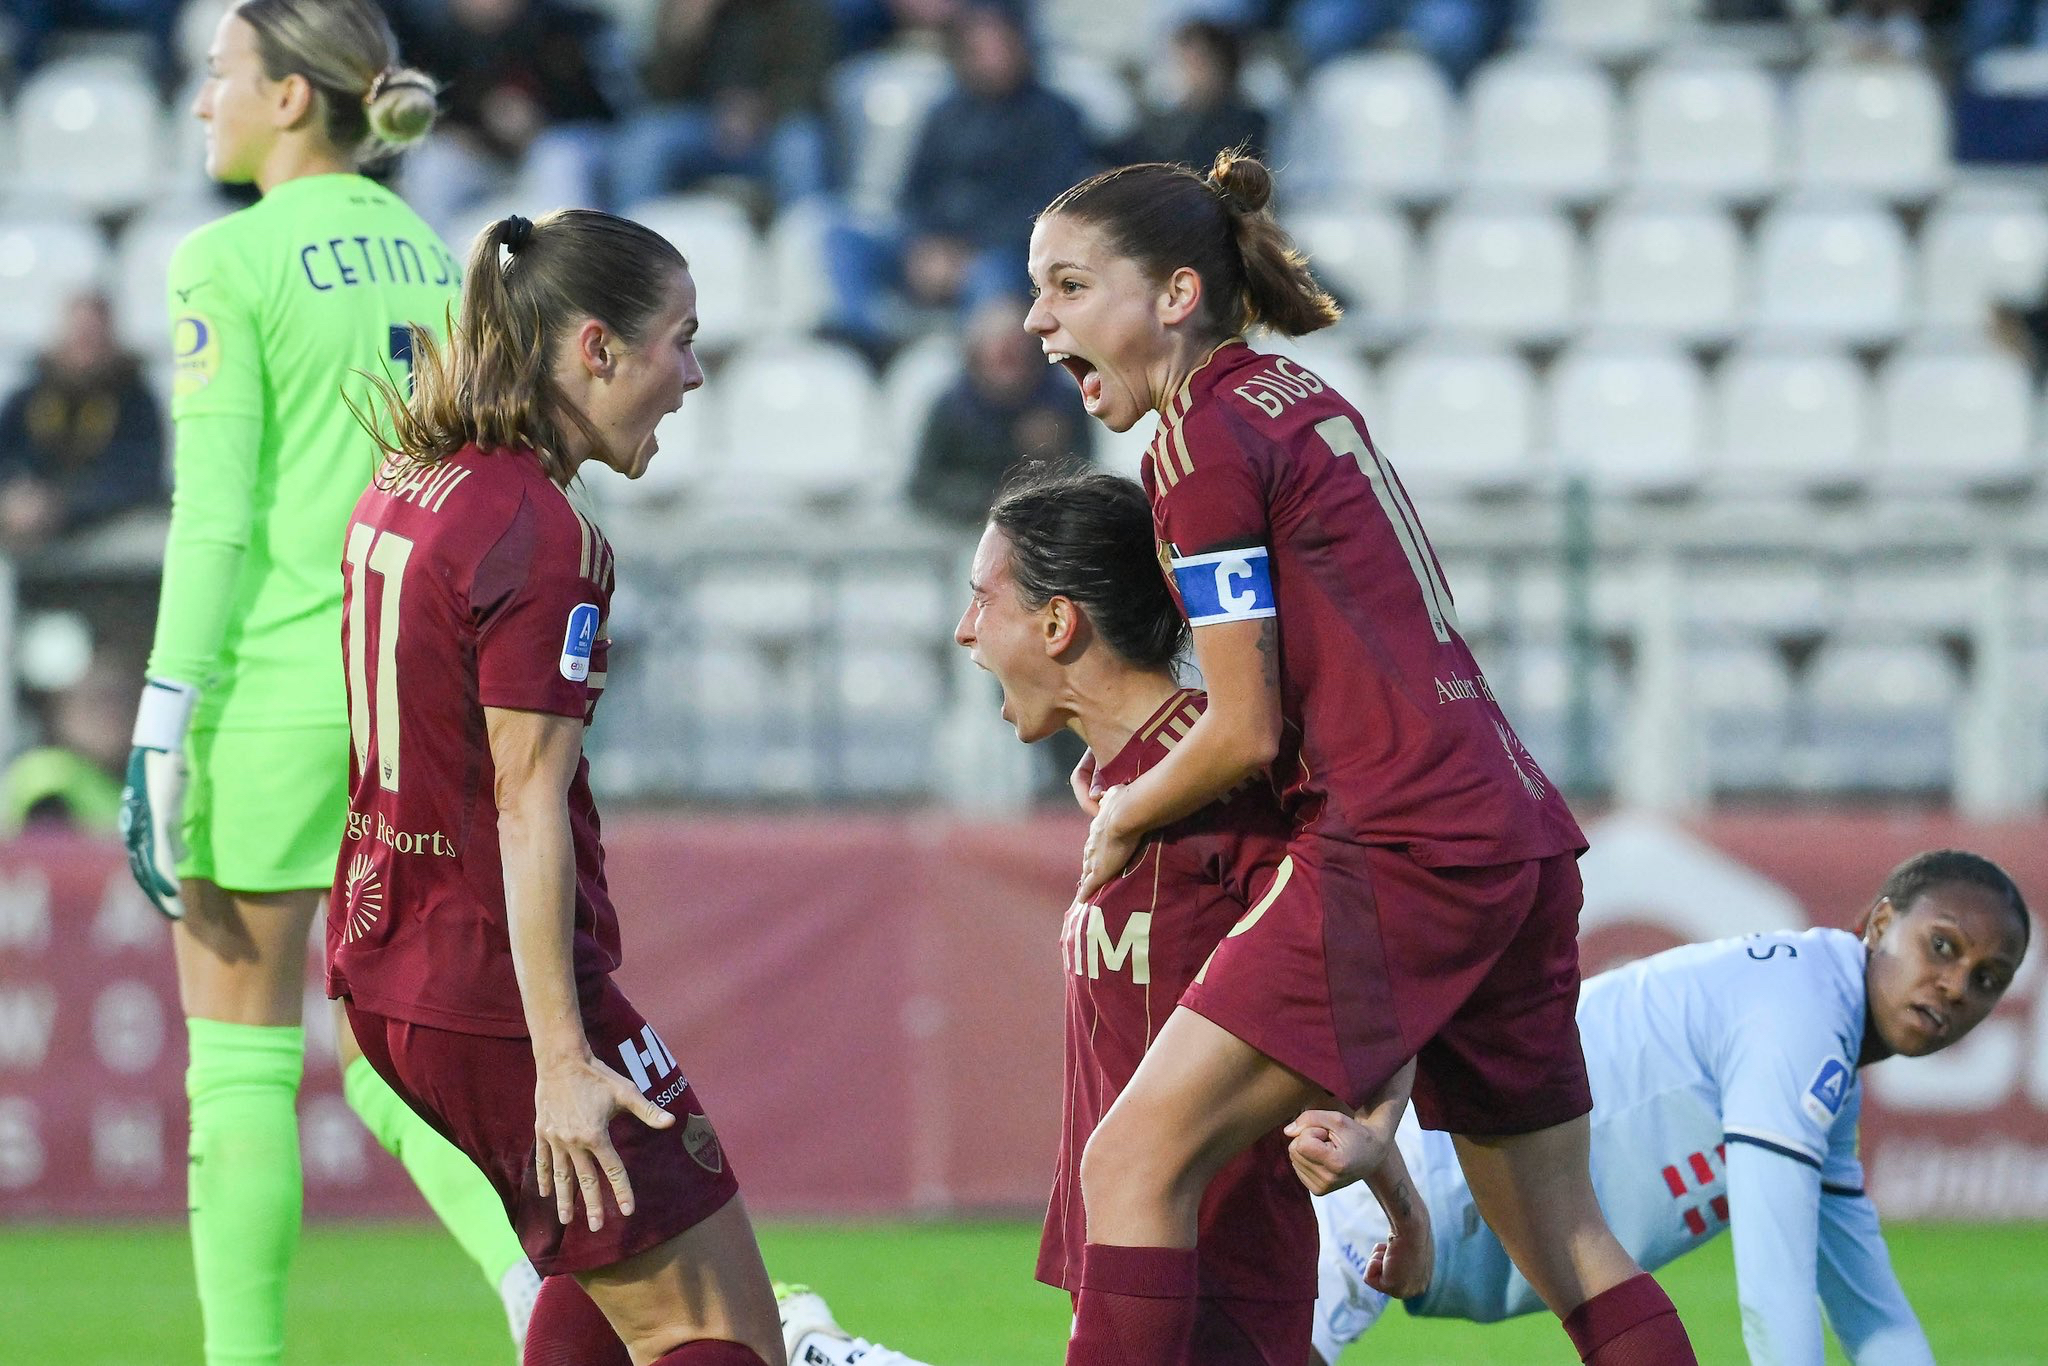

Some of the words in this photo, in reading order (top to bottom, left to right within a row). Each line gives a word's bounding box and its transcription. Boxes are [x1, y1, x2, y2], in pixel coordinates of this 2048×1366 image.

[302, 236, 463, 291] CETINJ
[1214, 559, 1257, 613] C
[346, 522, 415, 793] 11
[376, 810, 456, 858] Reorts
[651, 1075, 689, 1108] SSICUR
